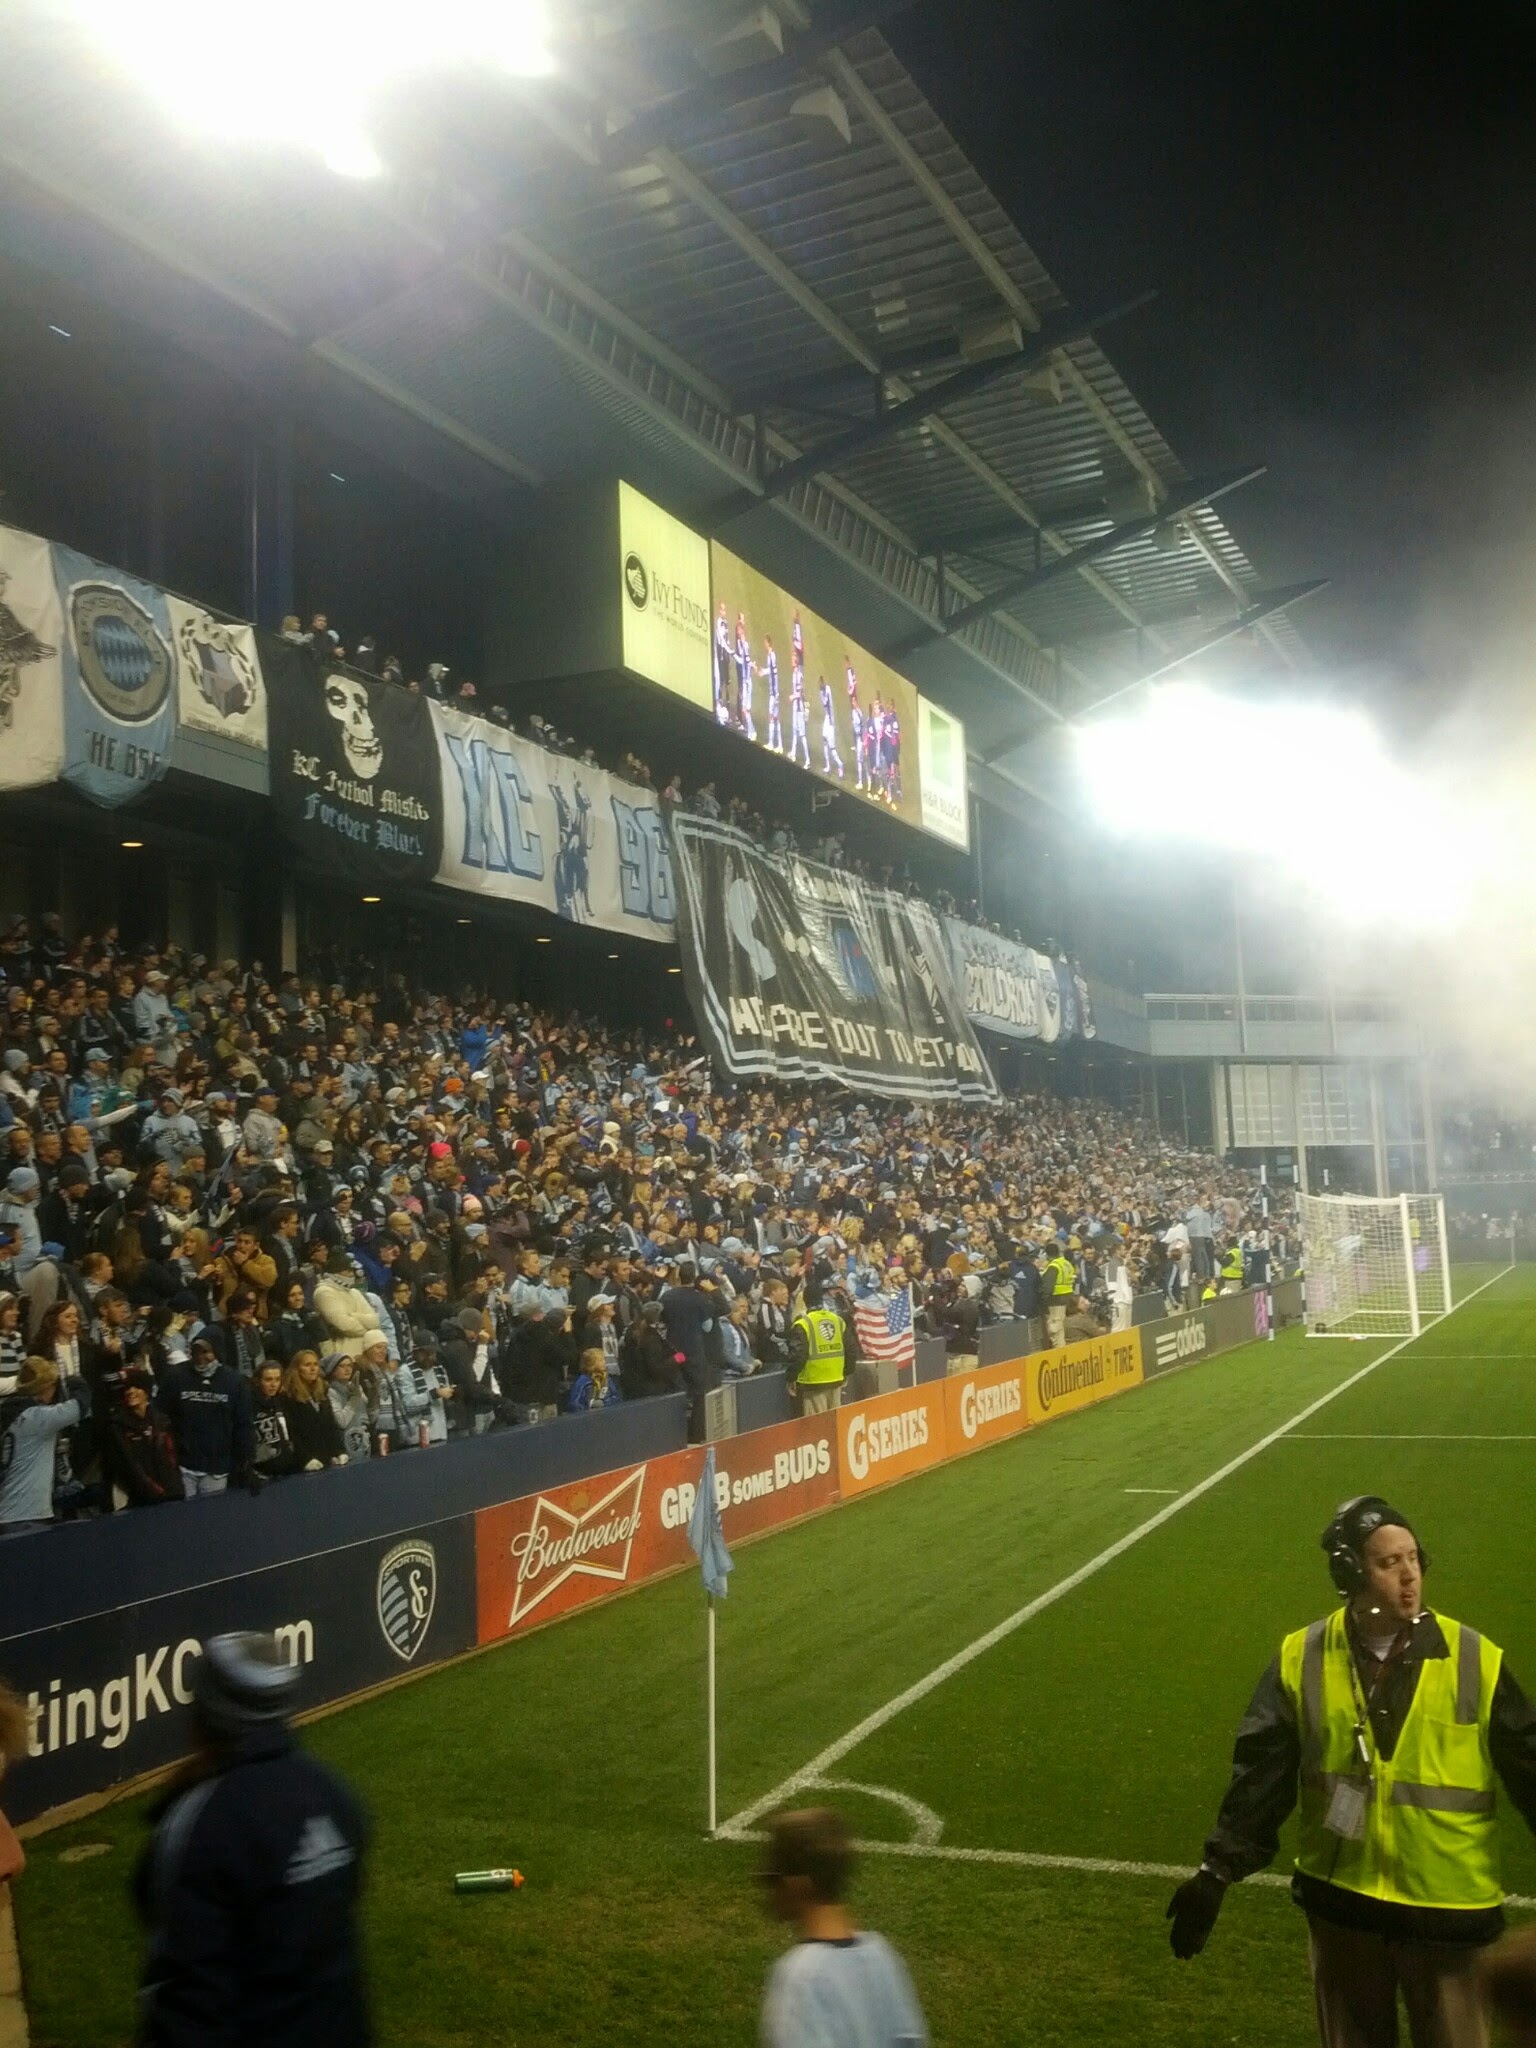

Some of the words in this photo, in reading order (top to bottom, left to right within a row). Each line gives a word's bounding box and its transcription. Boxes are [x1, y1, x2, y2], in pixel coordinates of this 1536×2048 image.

[652, 571, 670, 609] IVY
[672, 583, 708, 633] FUNDS
[446, 732, 545, 882] KC
[830, 1016, 882, 1061] OUT
[1176, 1316, 1206, 1358] adidas
[1037, 1345, 1105, 1412] Continental
[1113, 1344, 1135, 1377] TIRE
[660, 1471, 731, 1530] GRB
[732, 1469, 775, 1505] SOME
[774, 1438, 831, 1490] BUDS
[511, 1508, 641, 1584] Budweiser
